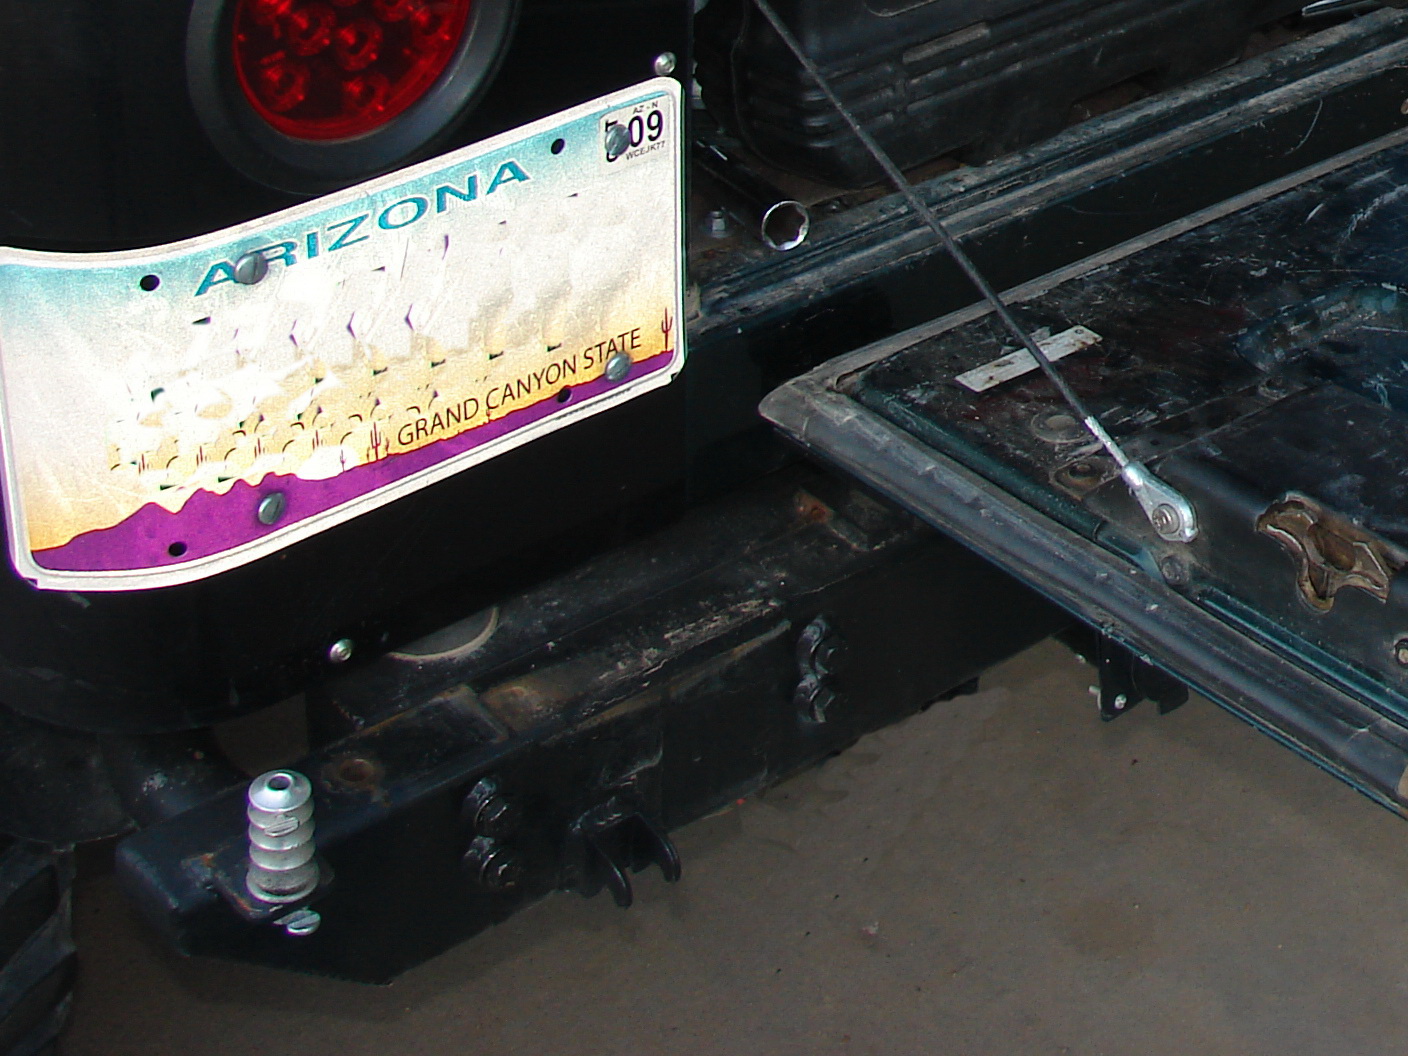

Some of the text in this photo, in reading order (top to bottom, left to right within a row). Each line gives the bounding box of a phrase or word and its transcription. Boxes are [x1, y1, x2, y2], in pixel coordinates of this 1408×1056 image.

[628, 109, 664, 148] 09
[193, 160, 531, 298] ARIZONA
[397, 327, 642, 447] GRAND CANYON STATE
